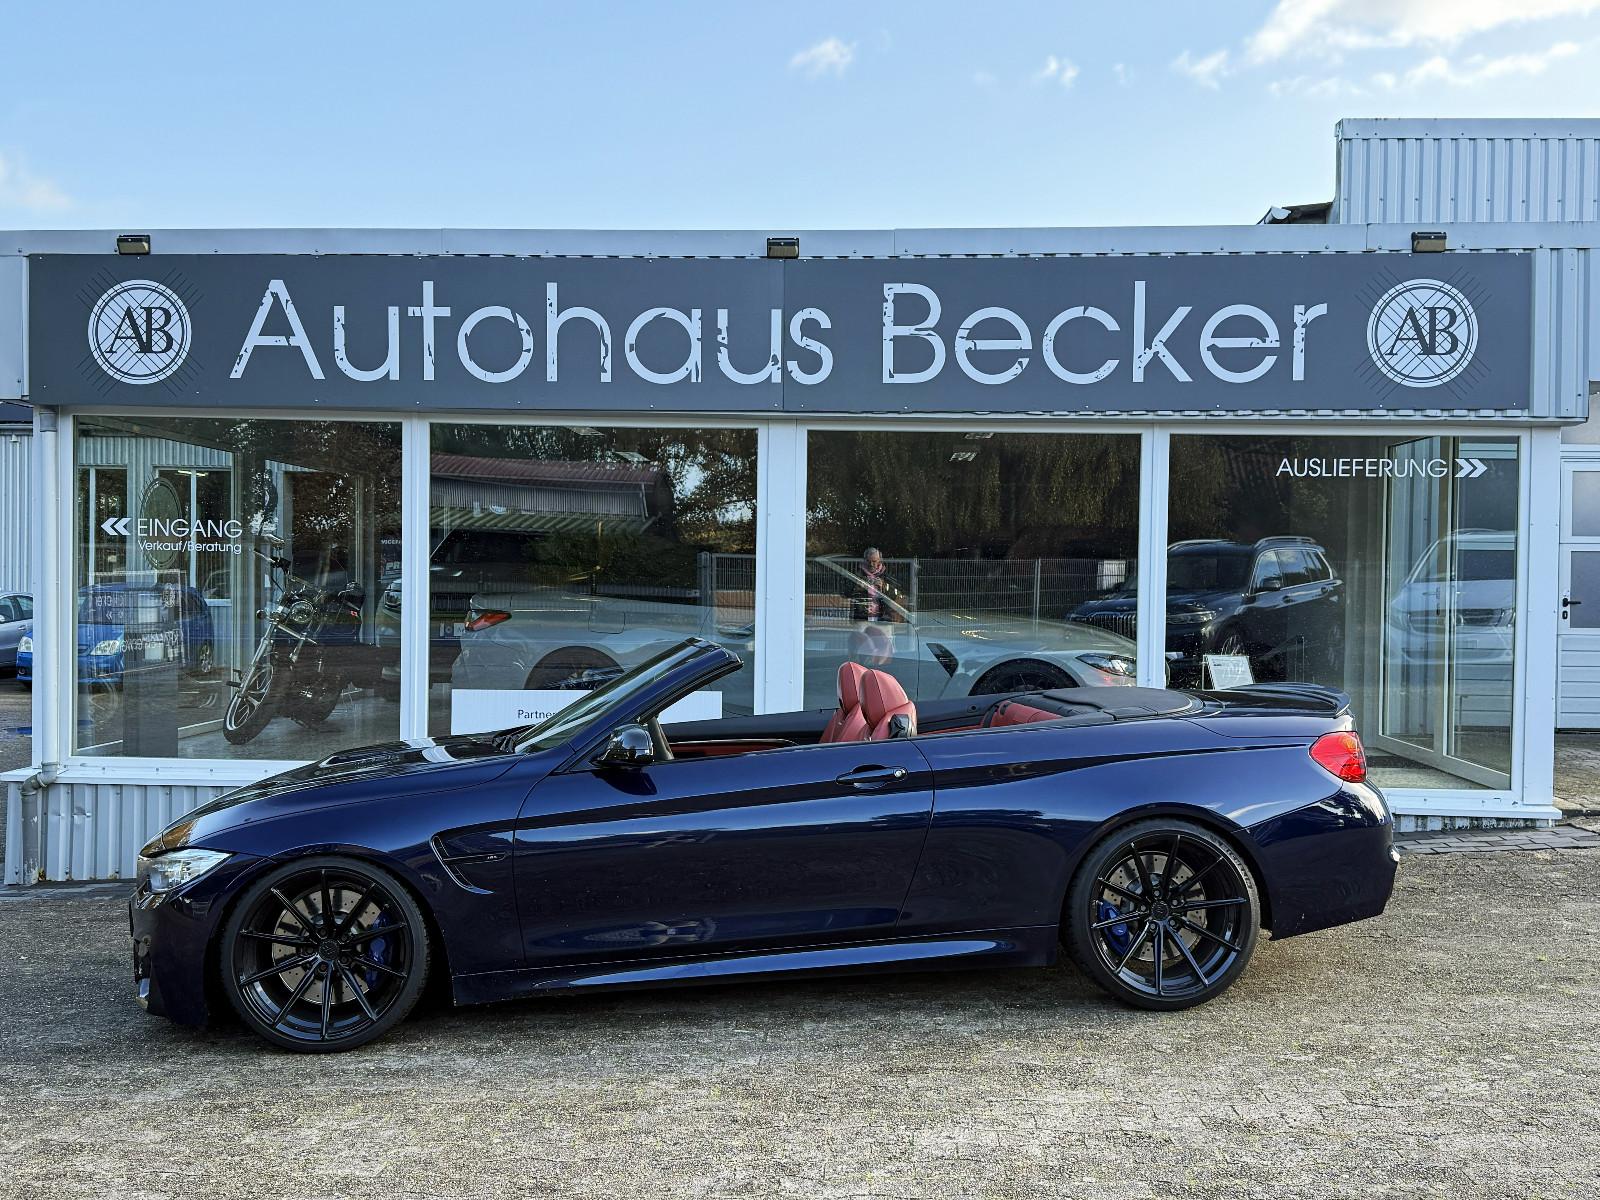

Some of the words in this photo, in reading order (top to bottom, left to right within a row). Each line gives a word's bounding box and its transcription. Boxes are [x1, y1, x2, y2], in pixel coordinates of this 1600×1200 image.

[105, 305, 174, 354] AB
[229, 279, 834, 386] Autohaus
[882, 280, 1328, 386] Becker
[1384, 305, 1459, 356] AB
[1275, 457, 1448, 479] AUSLIEFERUNG
[137, 518, 243, 538] EINGANG
[137, 539, 242, 555] Verkauf/Beratung
